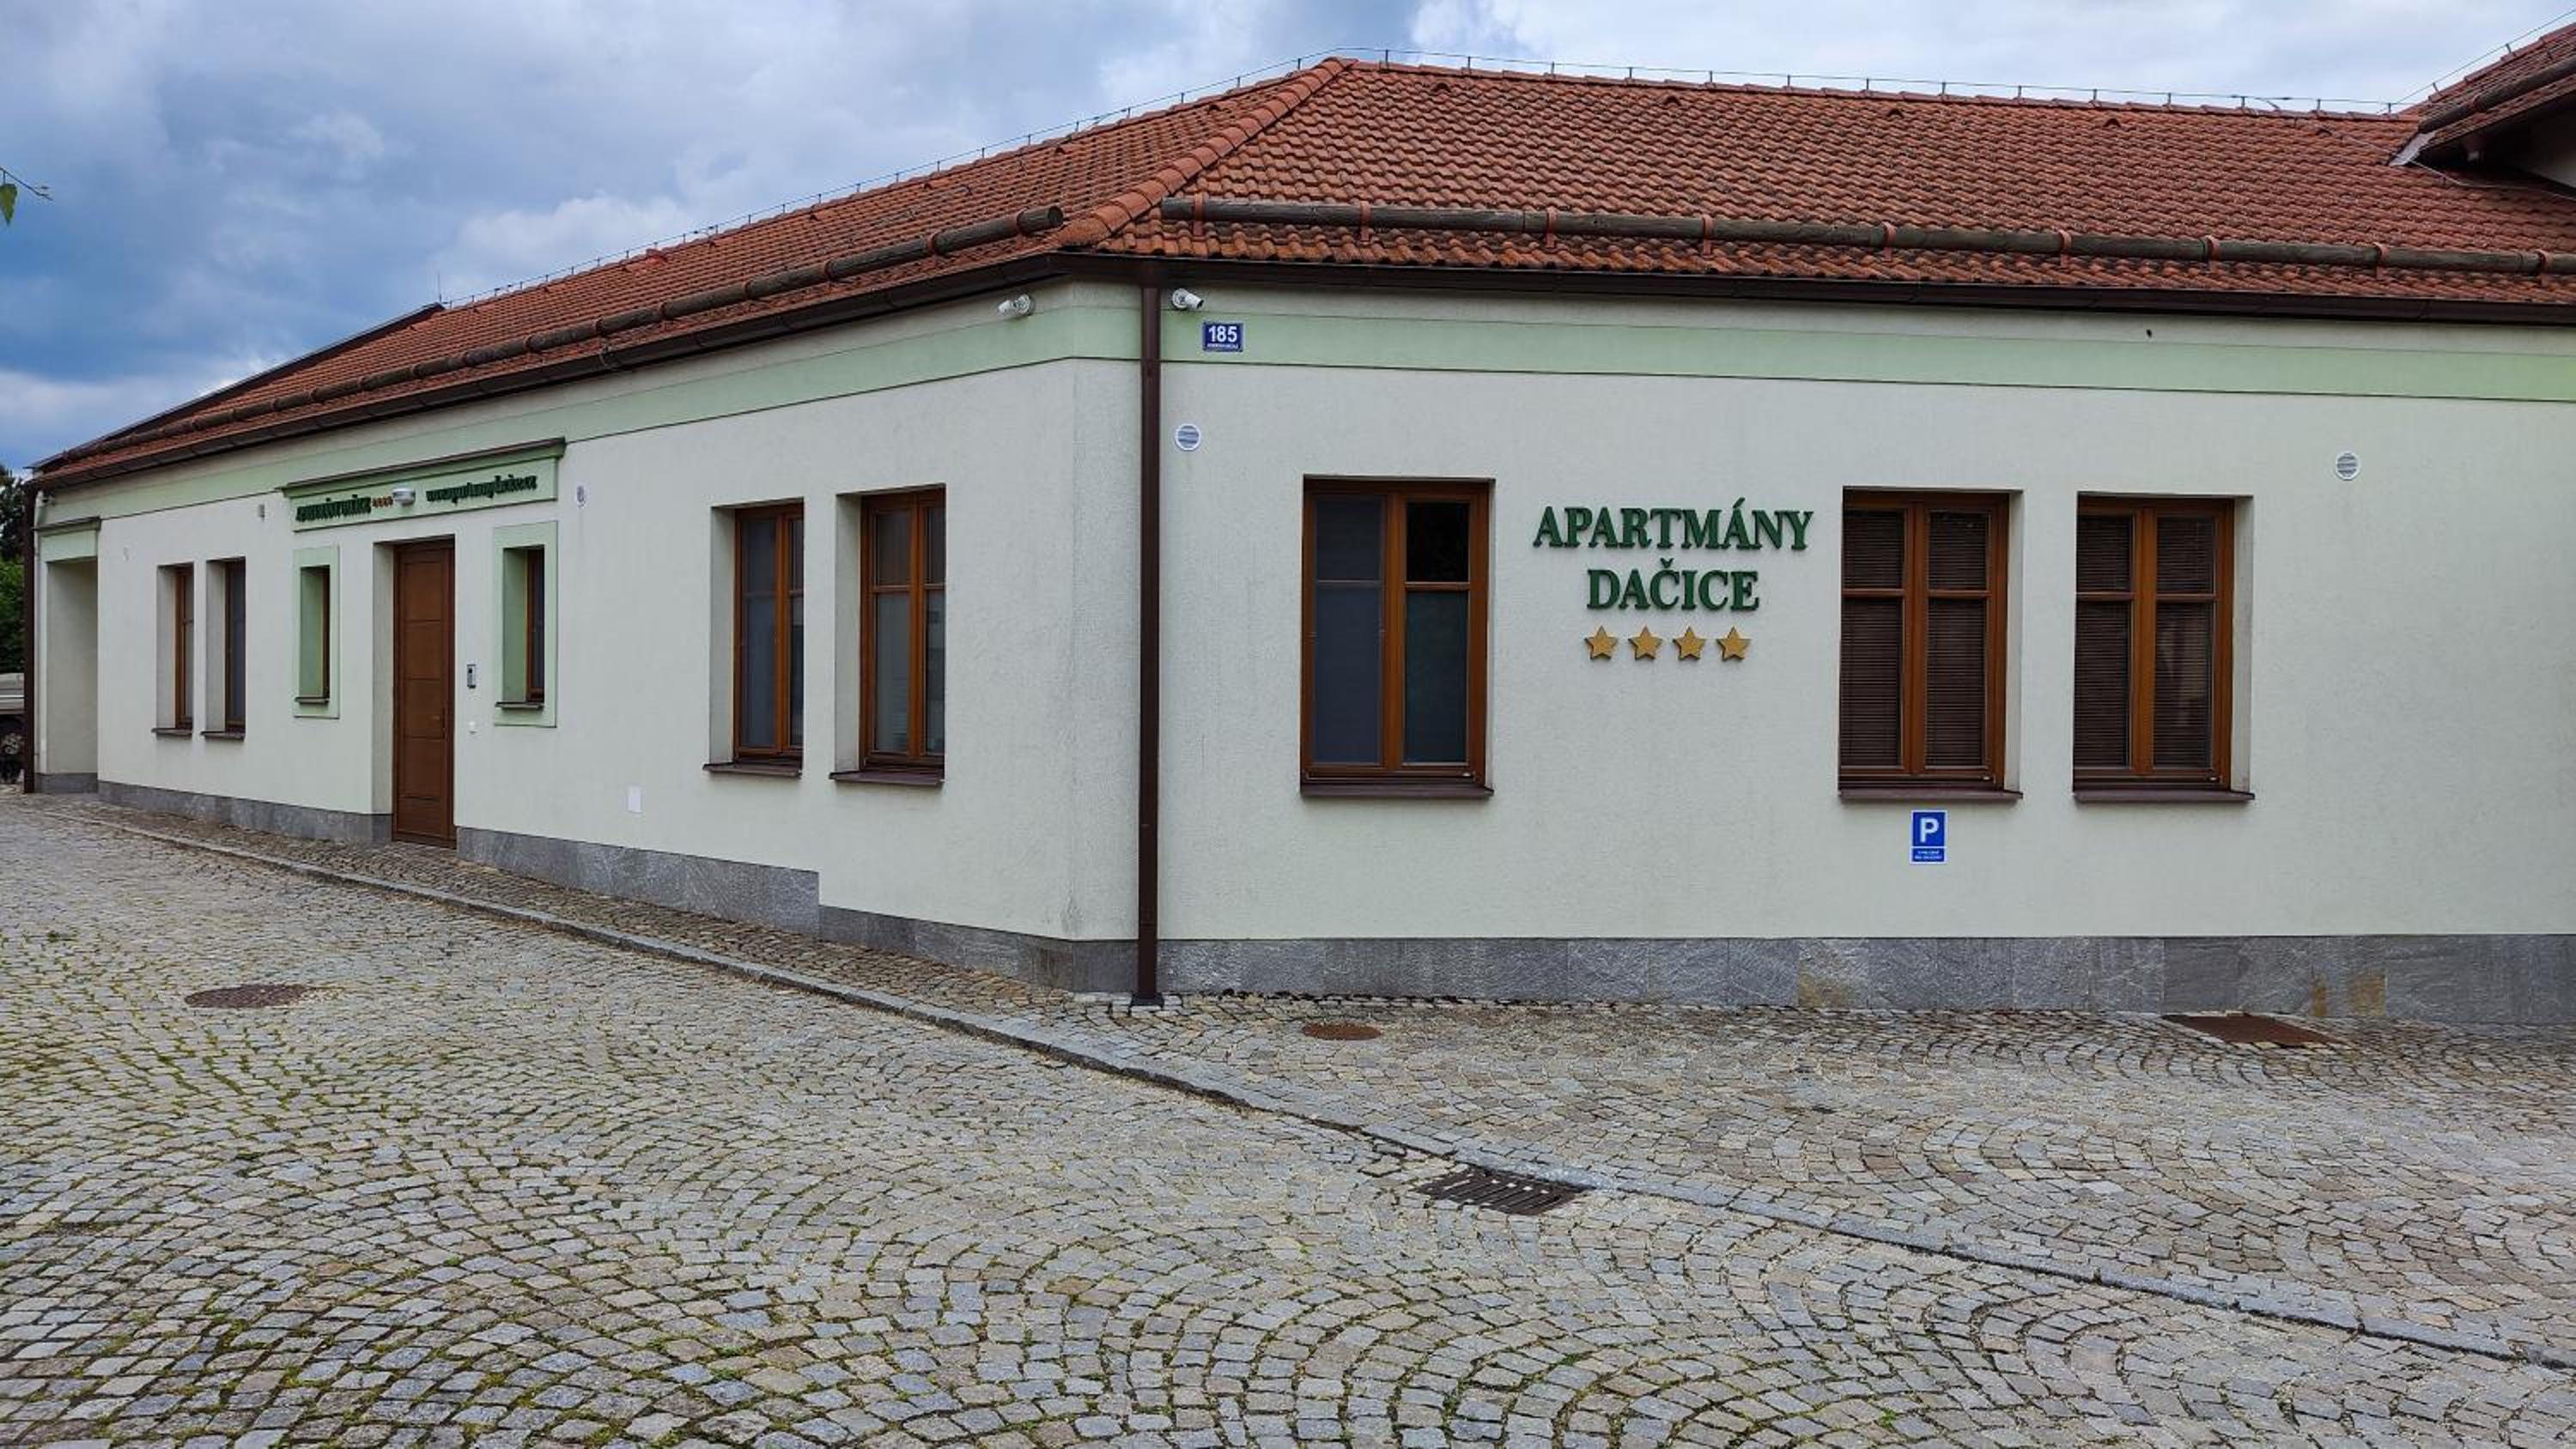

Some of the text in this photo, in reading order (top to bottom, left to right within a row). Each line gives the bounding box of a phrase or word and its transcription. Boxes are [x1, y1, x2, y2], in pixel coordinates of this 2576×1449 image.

[1208, 325, 1237, 343] 185
[1533, 497, 1814, 550] APARTMÁNY
[1587, 558, 1759, 611] DAČICE
[1920, 817, 1939, 842] P
